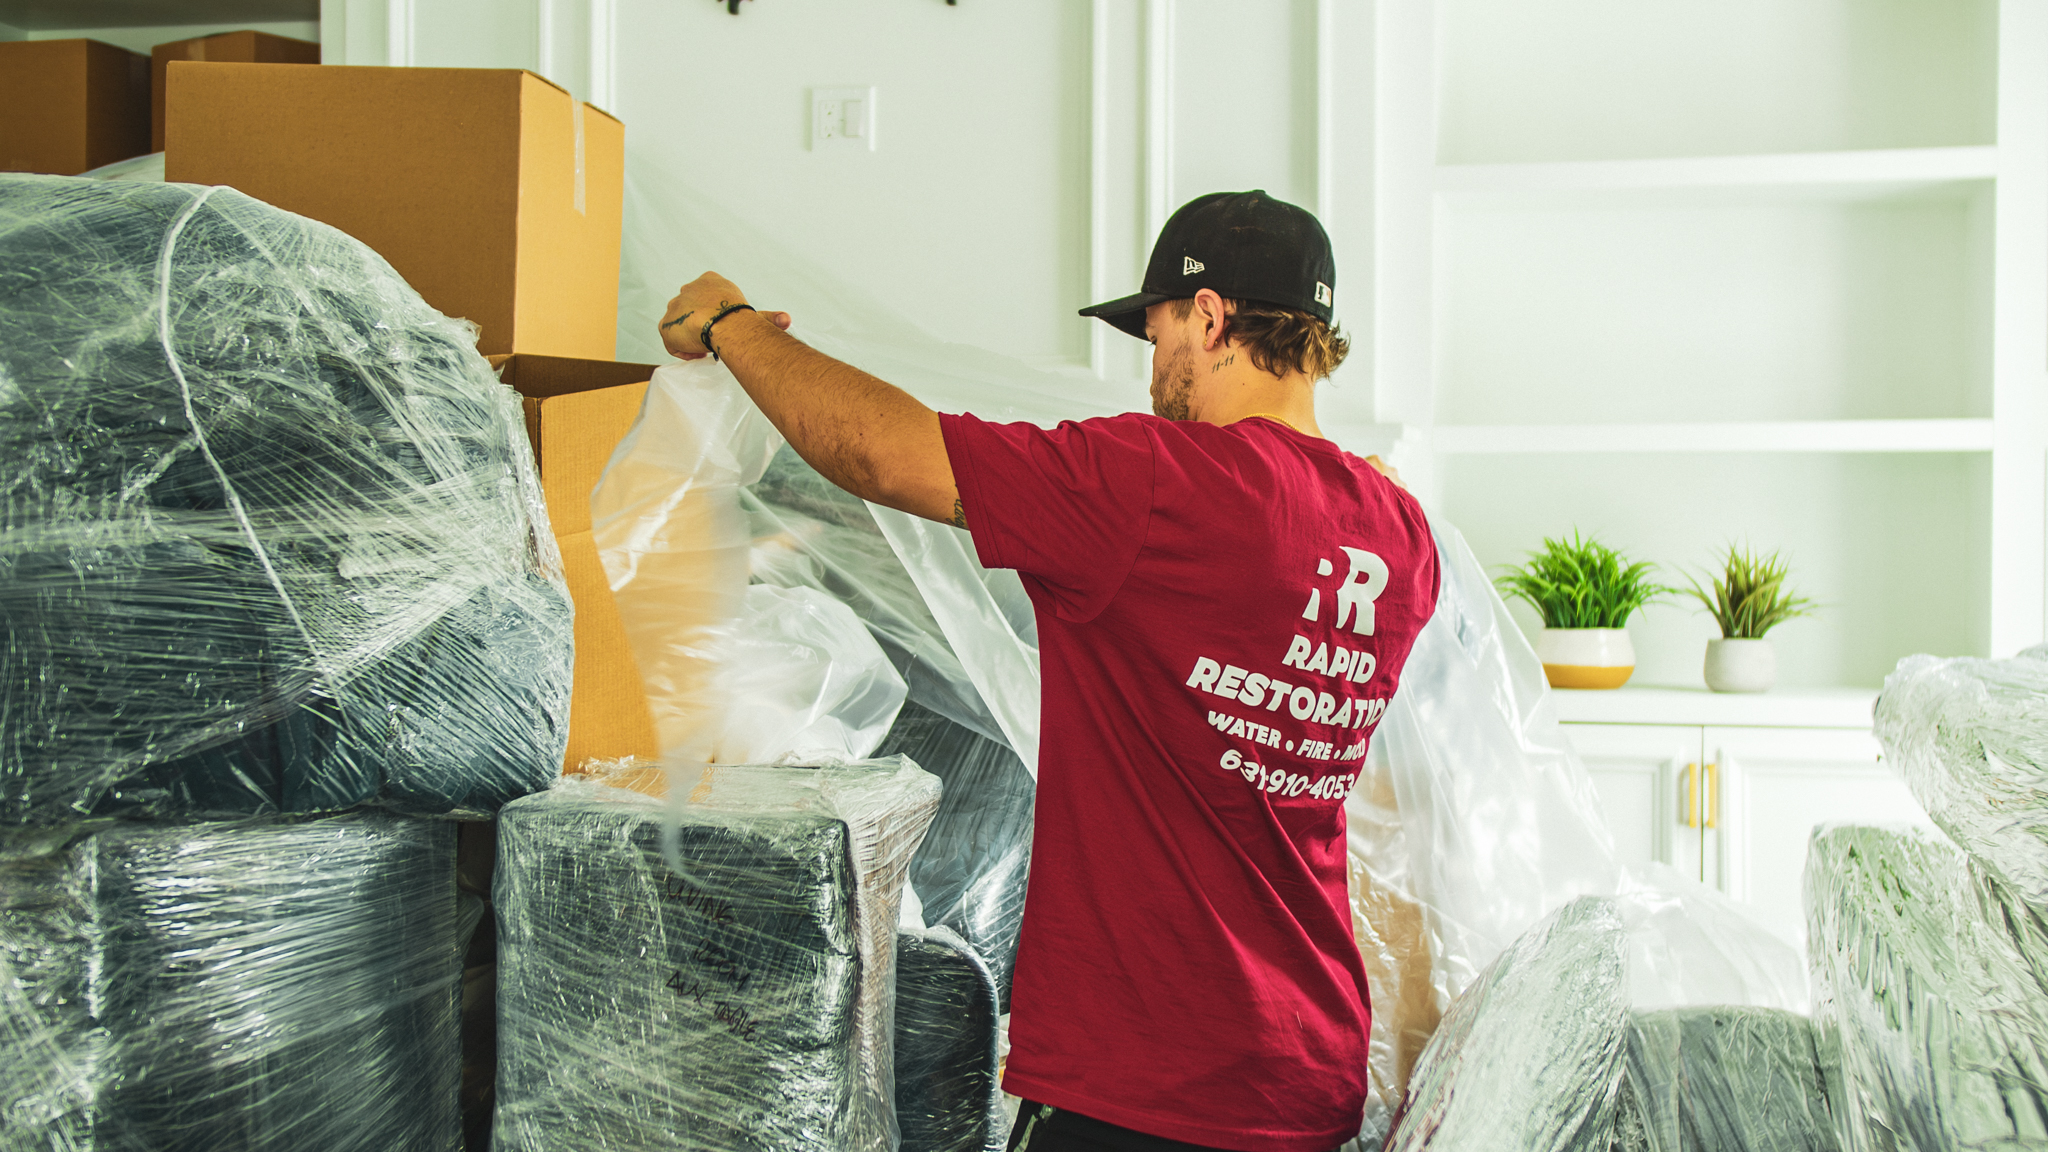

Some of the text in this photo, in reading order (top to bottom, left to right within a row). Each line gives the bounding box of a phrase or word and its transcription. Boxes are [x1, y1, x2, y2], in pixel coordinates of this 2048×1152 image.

[1281, 634, 1377, 684] RAPID
[1207, 710, 1282, 749] WATER
[1296, 738, 1334, 761] FIRE
[1219, 749, 1356, 801] 631-910-4053
